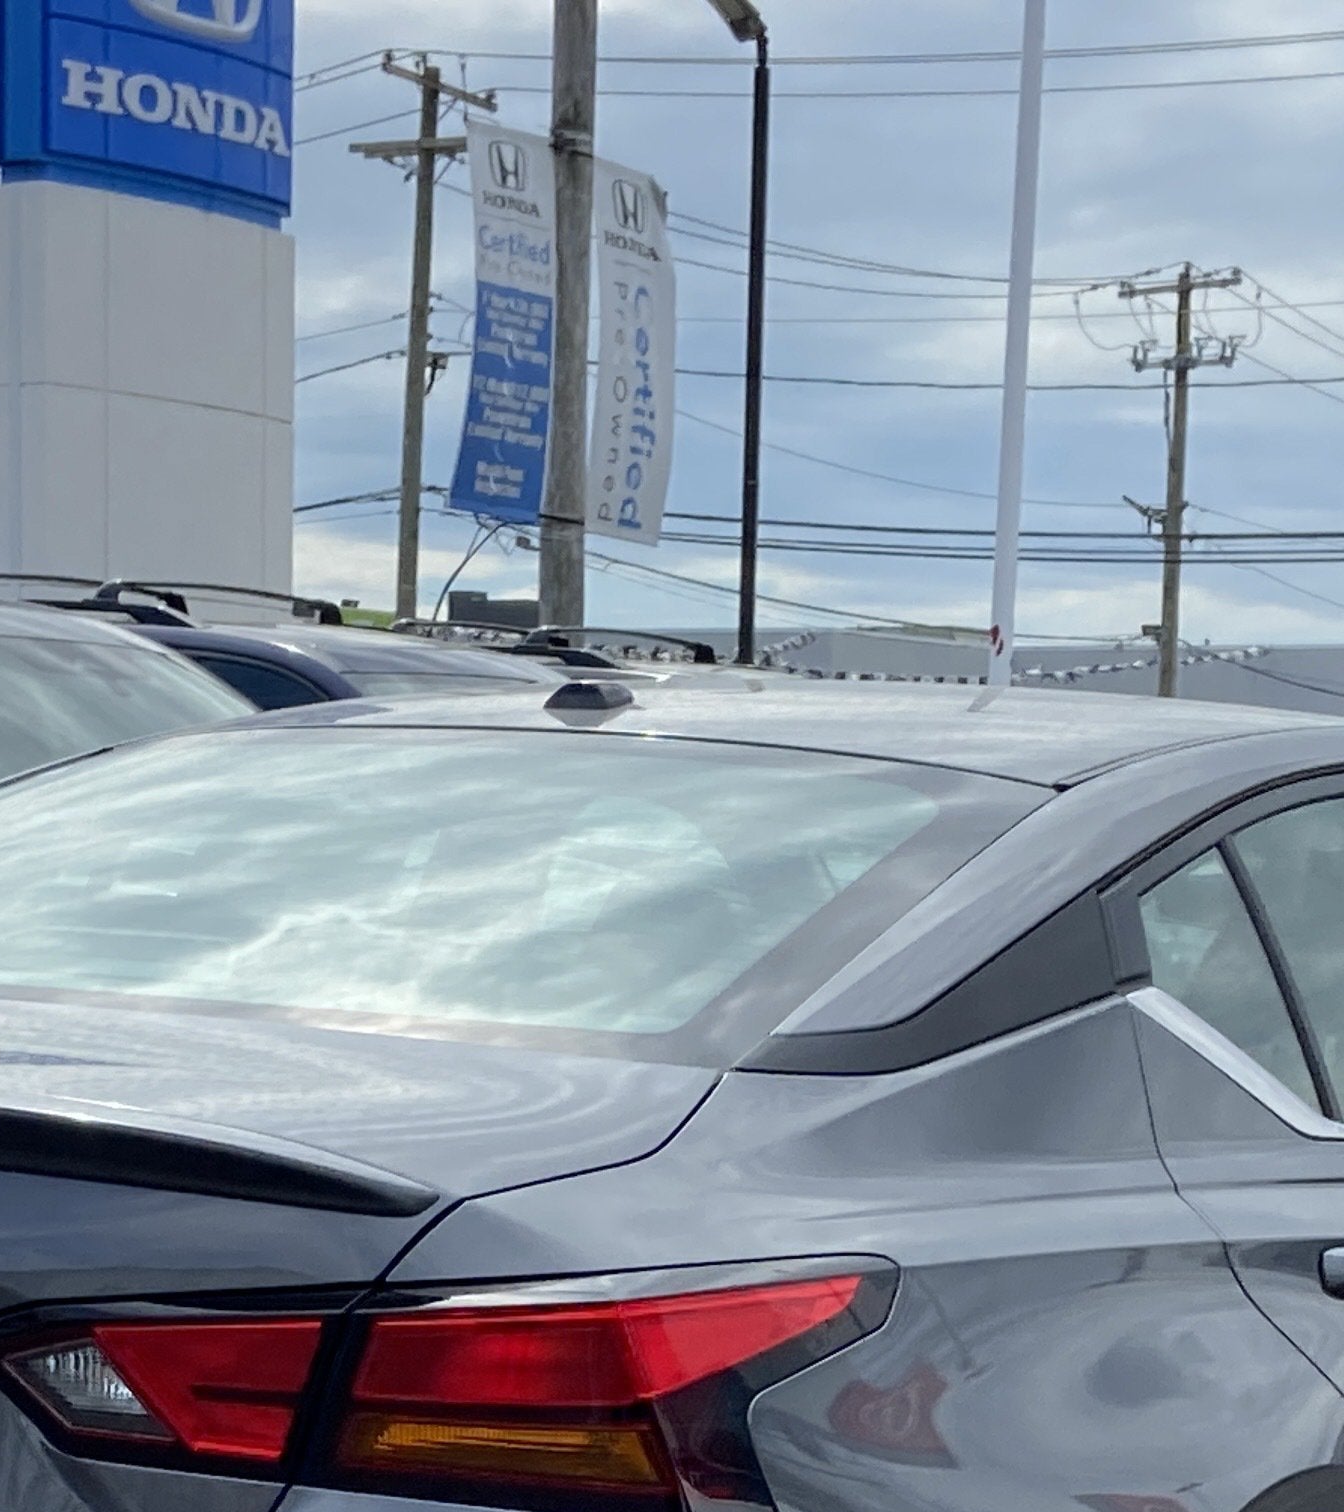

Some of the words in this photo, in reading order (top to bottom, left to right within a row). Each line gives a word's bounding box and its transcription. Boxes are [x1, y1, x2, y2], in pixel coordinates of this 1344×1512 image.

[62, 59, 290, 158] HONDA
[482, 191, 541, 218] HONDA
[479, 225, 550, 266] Certified
[604, 230, 663, 263] HONDA
[617, 286, 657, 530] Certified
